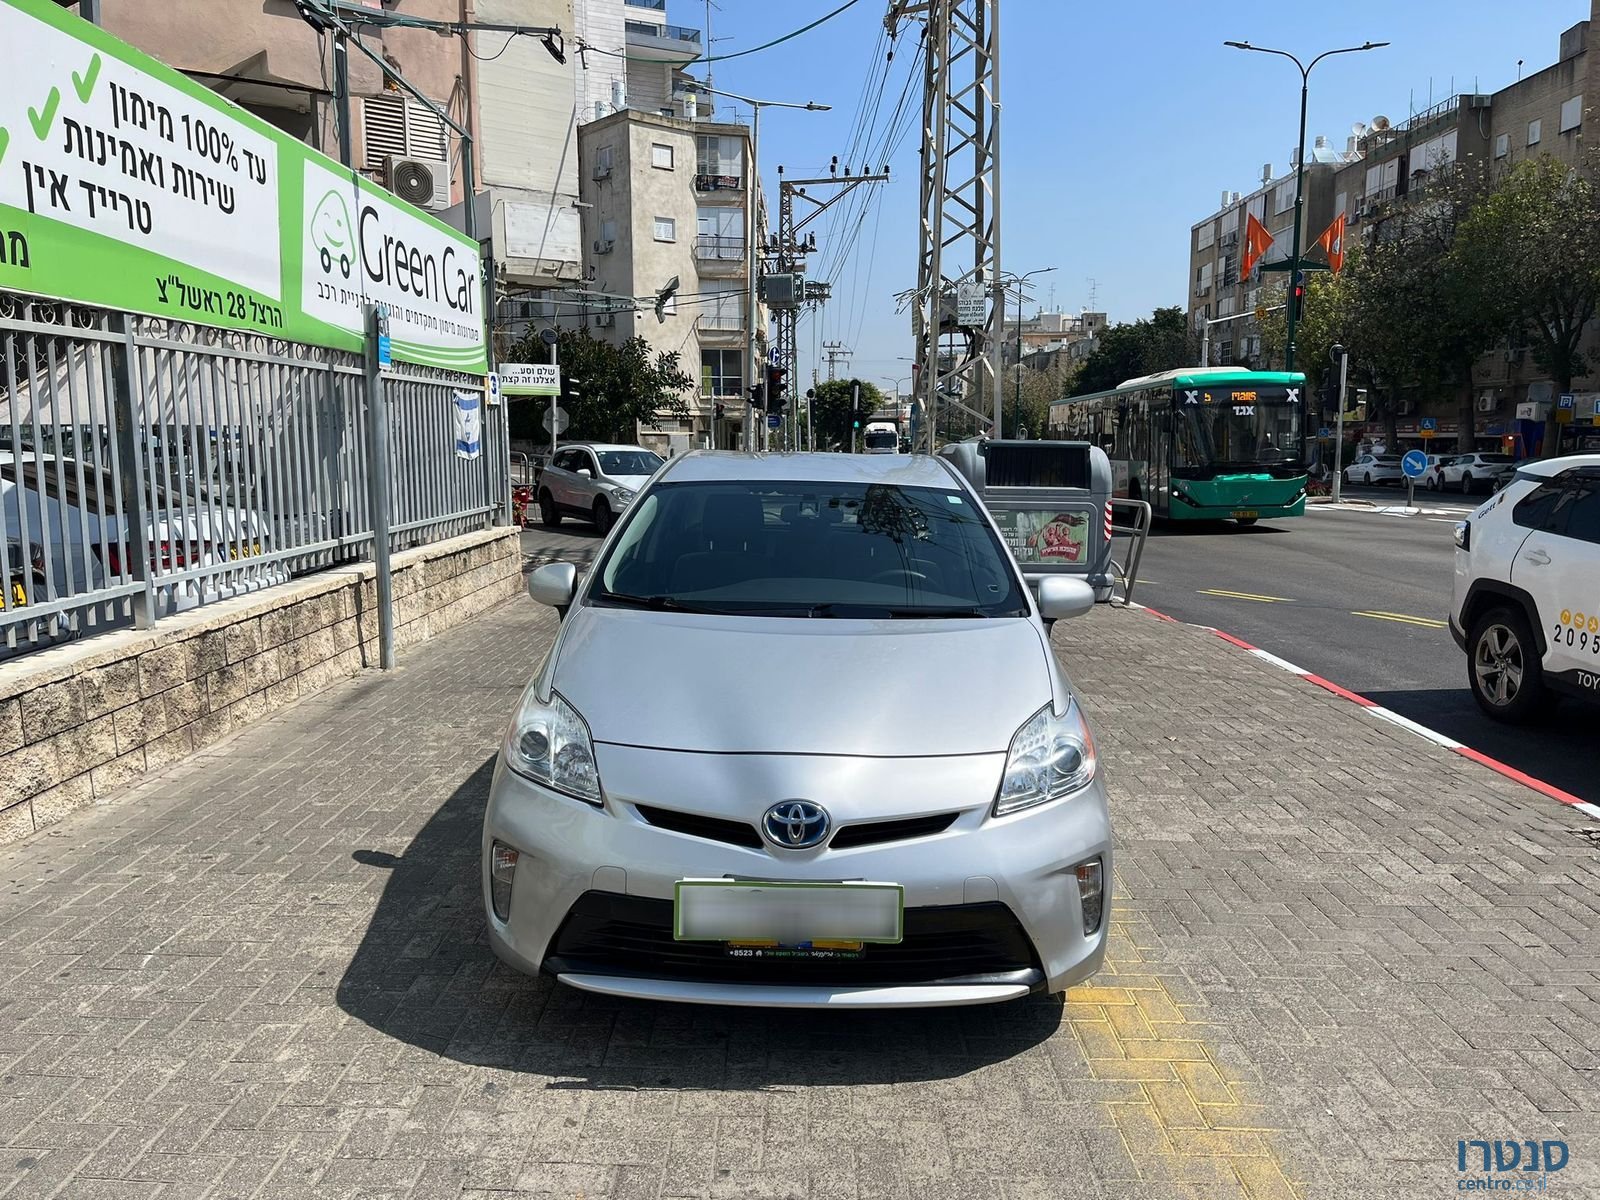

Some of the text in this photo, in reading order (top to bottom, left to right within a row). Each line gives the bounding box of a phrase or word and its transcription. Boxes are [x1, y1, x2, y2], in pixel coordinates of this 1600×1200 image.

[110, 81, 267, 185] עד 100% מימון
[63, 116, 235, 215] שירות ואמינות
[22, 160, 152, 235] טרייד אין
[360, 205, 474, 314] Green Car
[317, 281, 337, 302] רכב
[228, 291, 246, 320] 28
[249, 295, 283, 328] הרצל
[405, 308, 438, 331] מתקדמים
[502, 375, 519, 384] קצת
[533, 376, 556, 384] אצלנו
[537, 366, 555, 375] שלם
[1577, 671, 1600, 690] TOY
